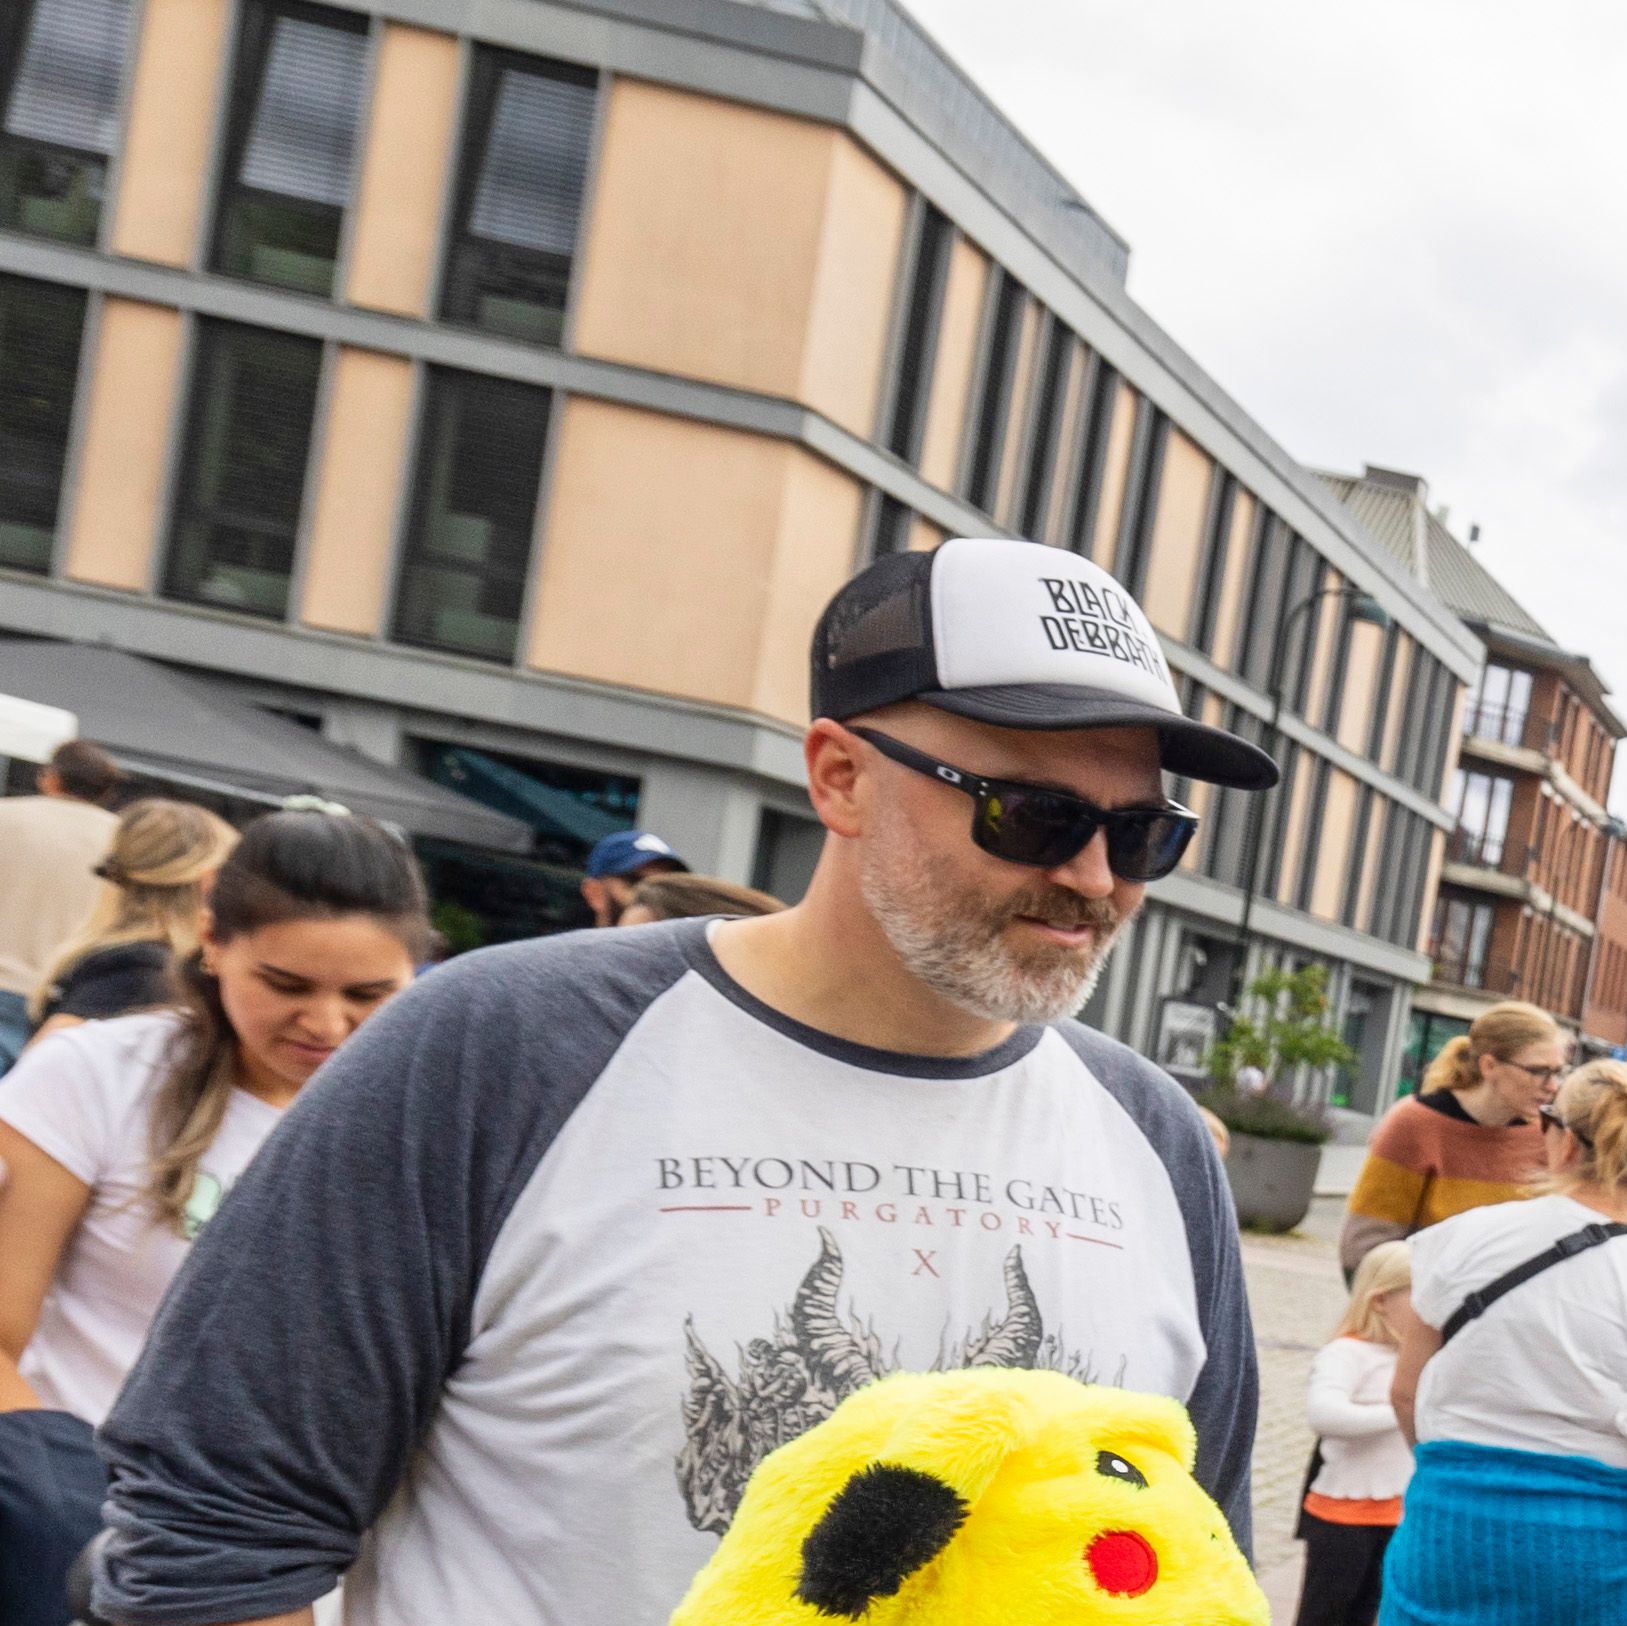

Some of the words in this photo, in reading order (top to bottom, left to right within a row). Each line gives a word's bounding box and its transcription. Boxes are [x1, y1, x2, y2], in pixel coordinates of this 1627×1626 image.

[1038, 578, 1138, 634] BLACK
[655, 1157, 880, 1192] BEYOND
[895, 1165, 993, 1204] THE
[1006, 1179, 1124, 1230] GATES
[763, 1198, 1062, 1240] PURGATORY
[911, 1248, 940, 1278] X
